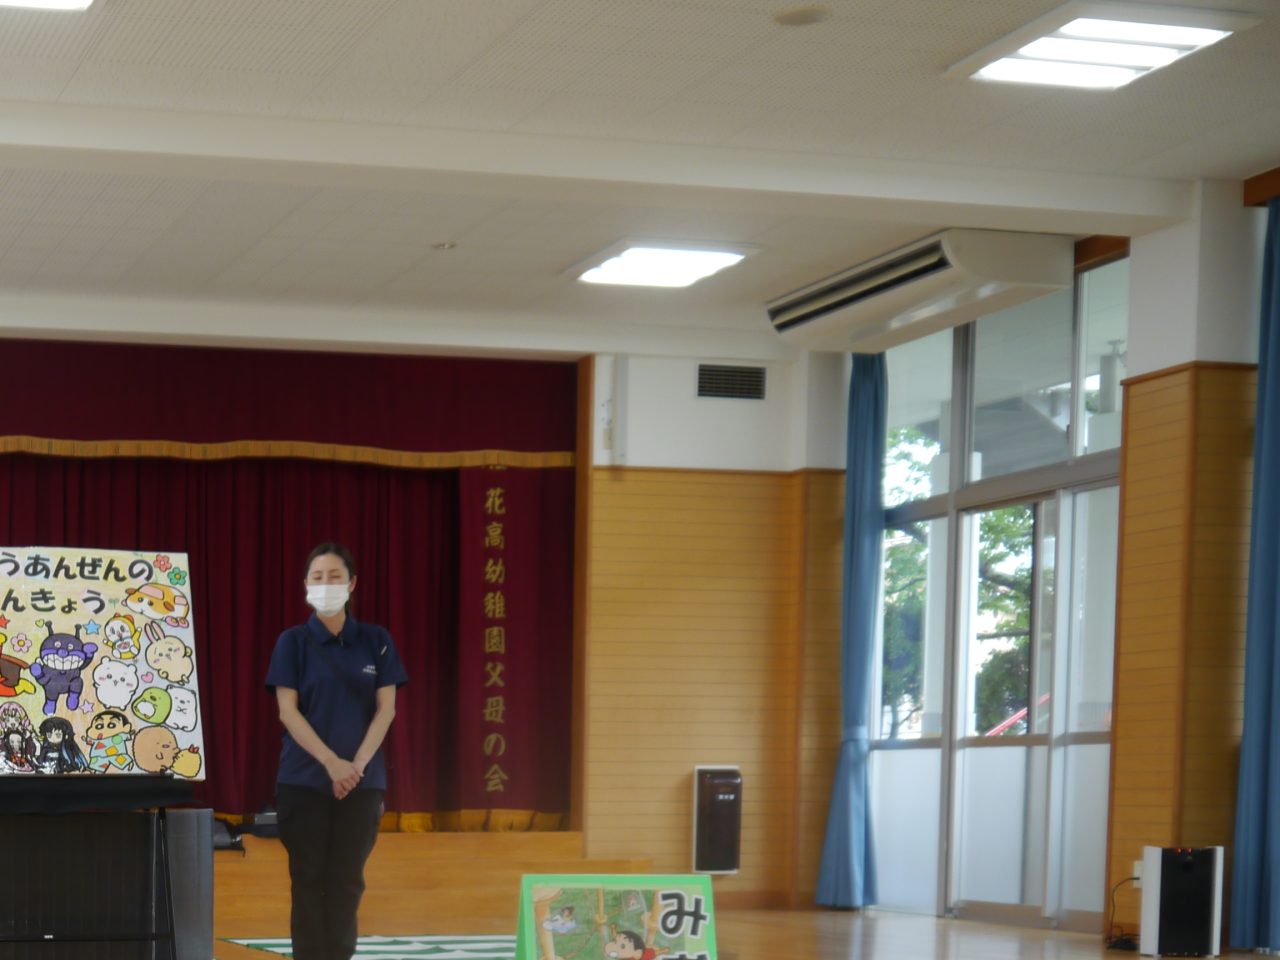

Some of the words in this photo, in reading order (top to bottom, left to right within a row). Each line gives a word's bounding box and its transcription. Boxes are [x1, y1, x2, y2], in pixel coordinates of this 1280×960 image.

[483, 487, 509, 791] 花高幼稚園父母の会
